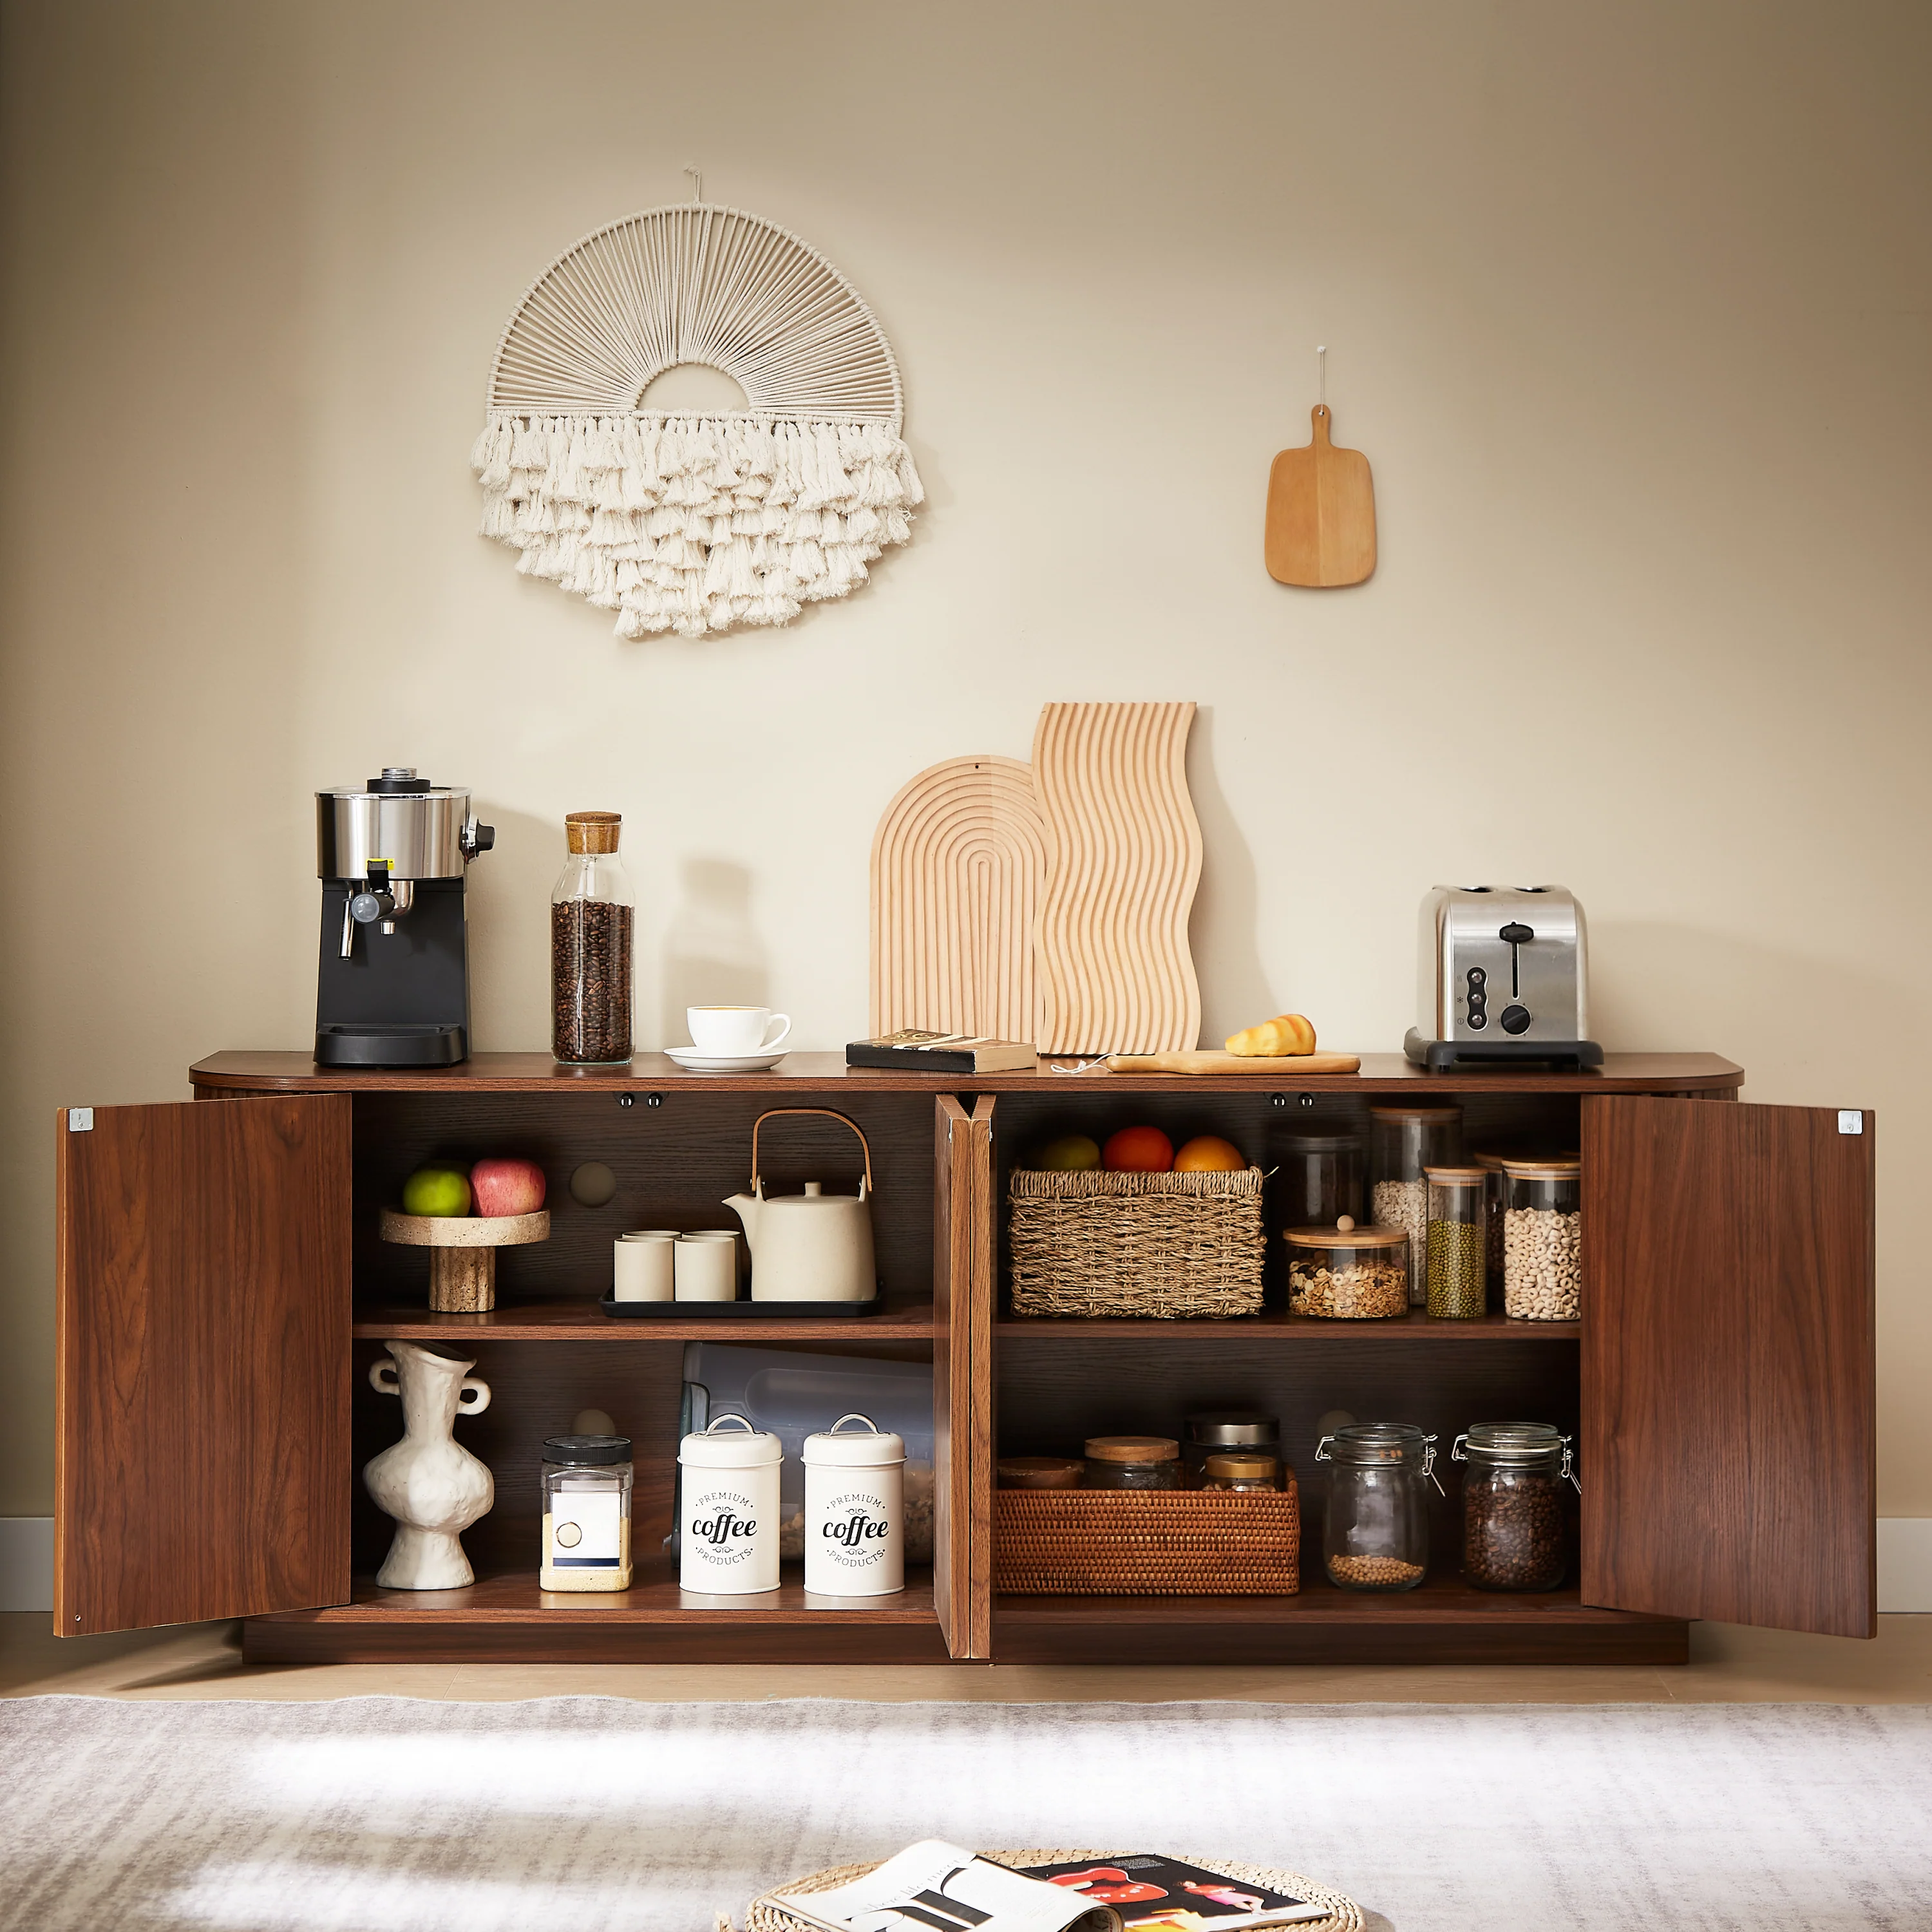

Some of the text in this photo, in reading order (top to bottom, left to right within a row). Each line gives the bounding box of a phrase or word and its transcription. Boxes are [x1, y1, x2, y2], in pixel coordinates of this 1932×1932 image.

[699, 1492, 749, 1506] PREMIUM
[830, 1494, 882, 1508] PREMIUM
[692, 1514, 757, 1544] coffee
[823, 1516, 889, 1546] coffee
[697, 1548, 752, 1565] PRODUCTS
[829, 1550, 884, 1567] PRODUCTS
